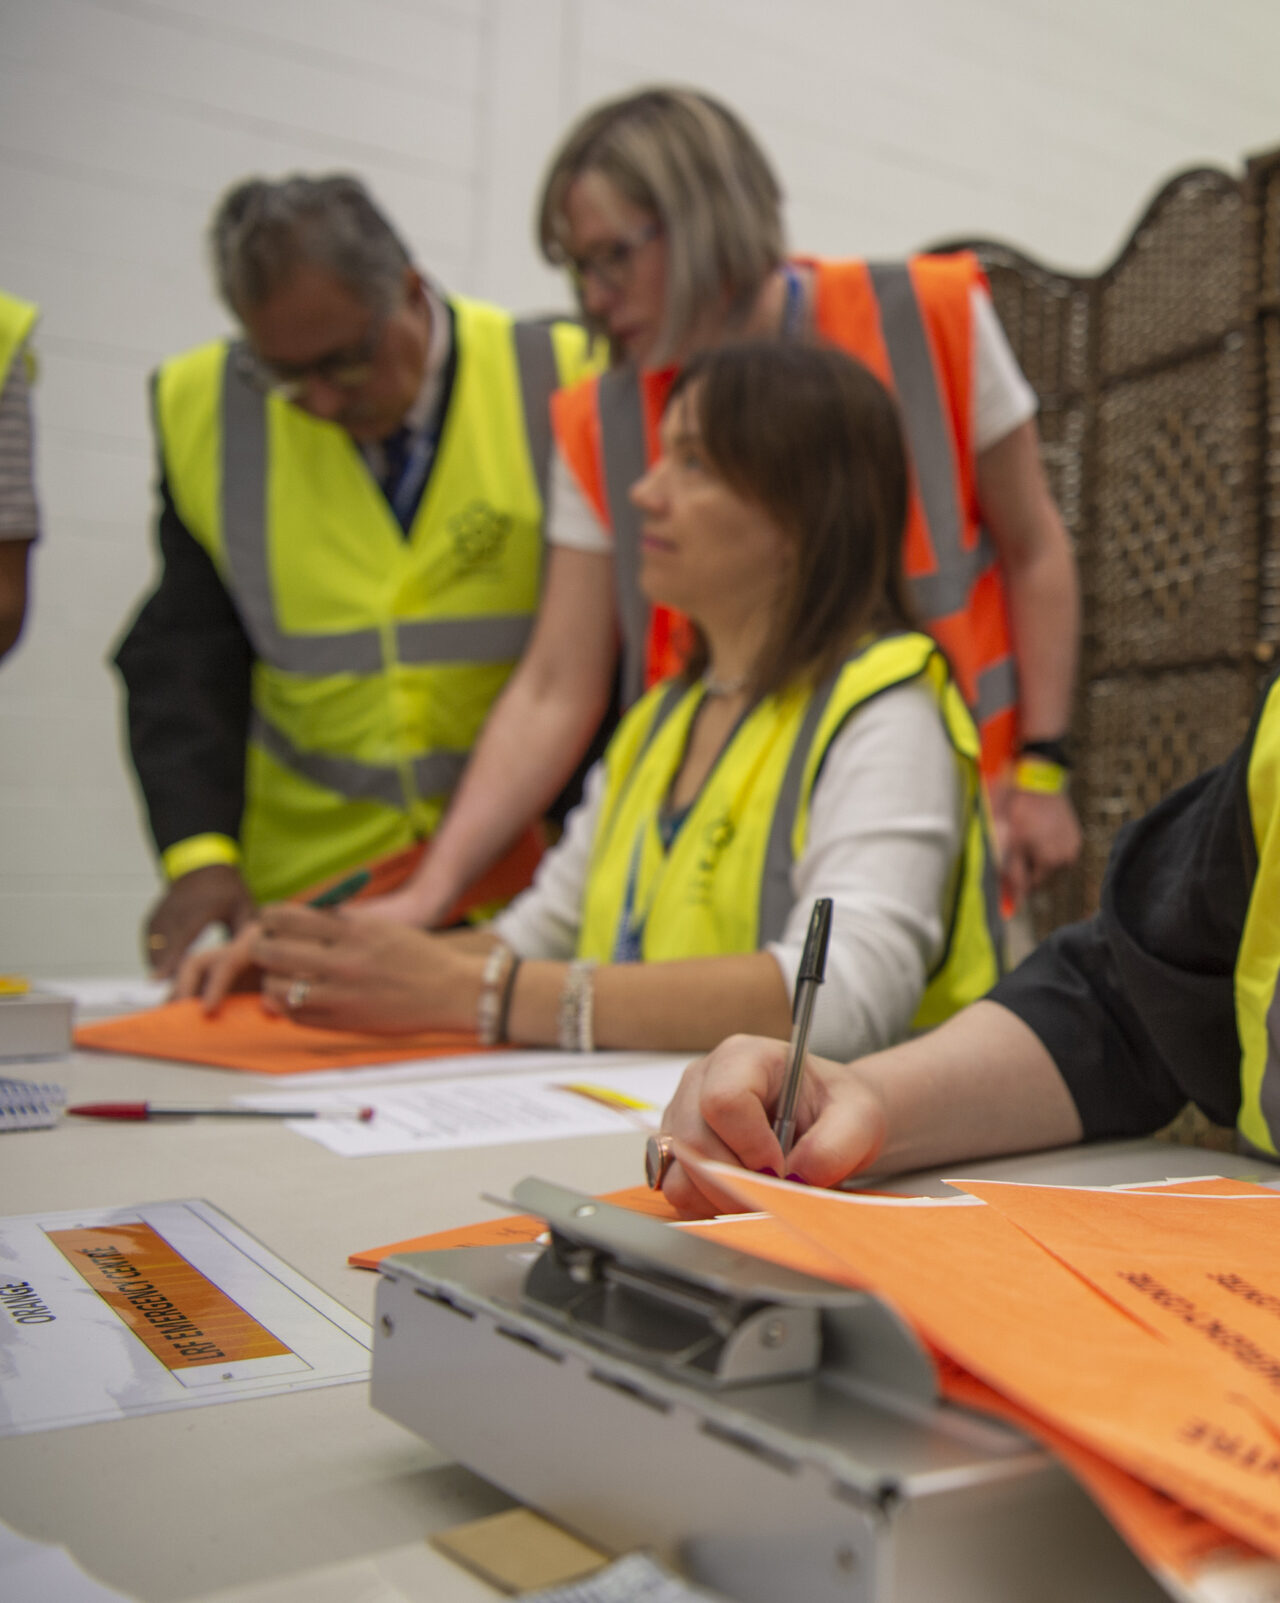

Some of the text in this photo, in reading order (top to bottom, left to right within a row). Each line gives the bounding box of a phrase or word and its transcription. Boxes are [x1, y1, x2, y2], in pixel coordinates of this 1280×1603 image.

[0, 1281, 57, 1324] ORANGE
[82, 1244, 227, 1362] LRF EMERGENCY CENTRE
